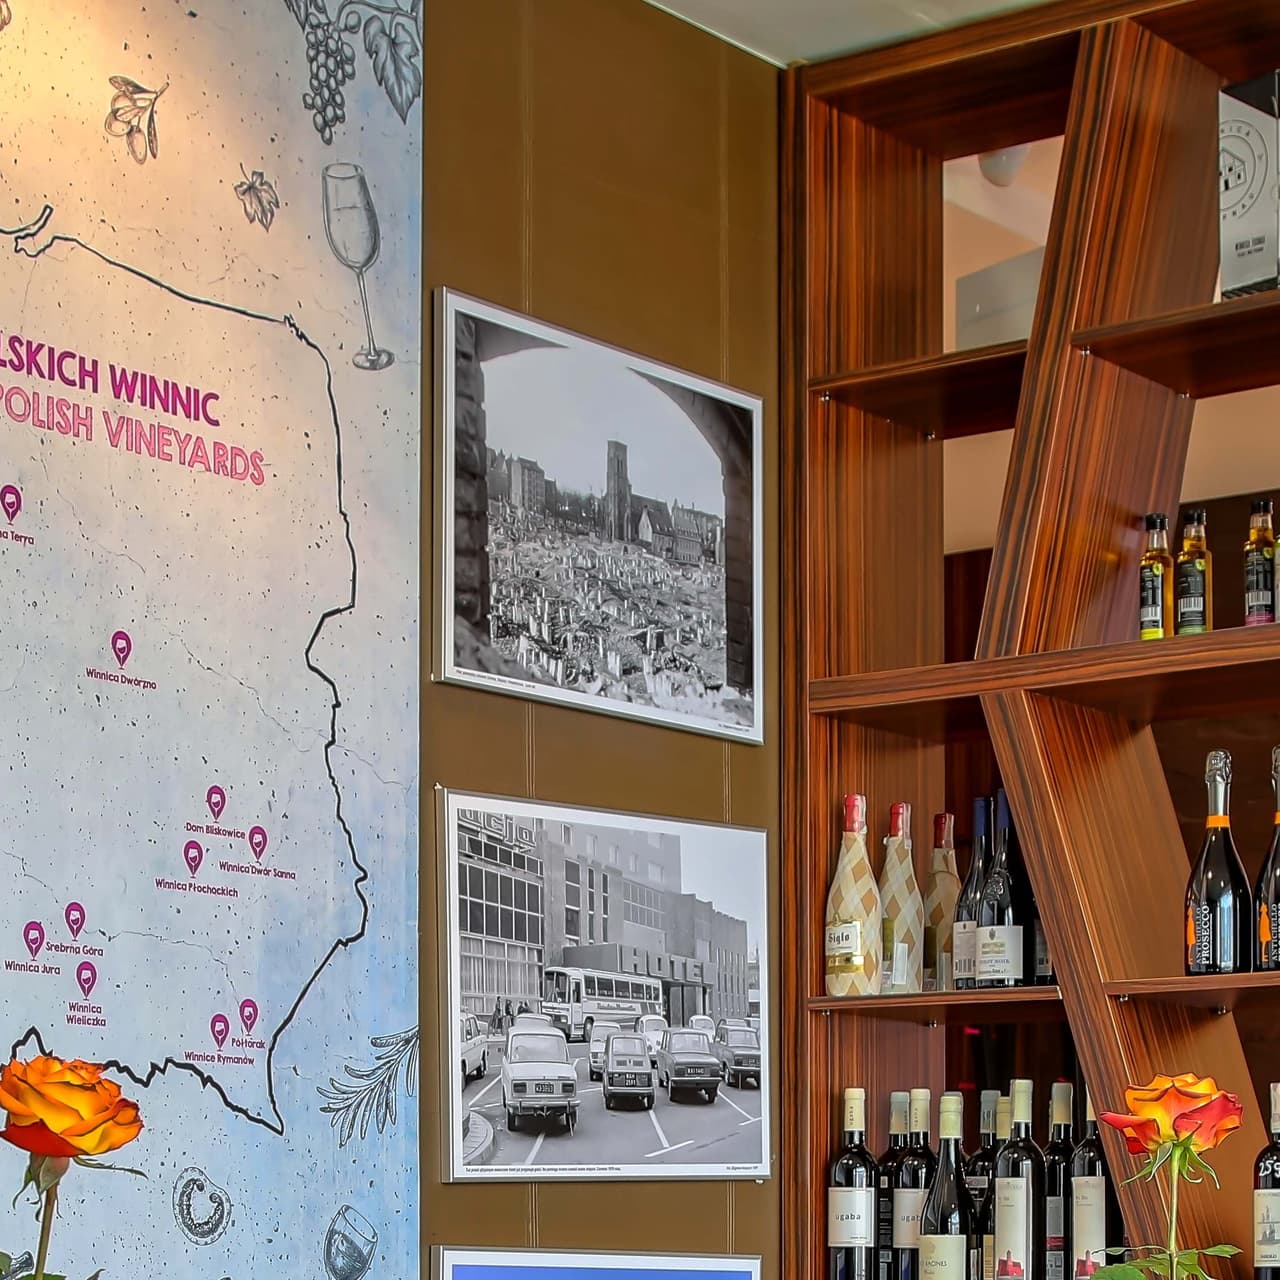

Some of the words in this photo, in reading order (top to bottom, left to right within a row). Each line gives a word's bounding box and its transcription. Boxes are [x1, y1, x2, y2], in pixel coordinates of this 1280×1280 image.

[108, 363, 220, 427] WINNIC
[102, 410, 265, 486] VINEYARDS
[10, 530, 35, 546] Terra
[86, 667, 120, 683] Winnica
[120, 675, 157, 690] Dwórzno
[186, 822, 205, 833] Dom
[219, 861, 250, 874] Winnica
[273, 868, 296, 880] Sanna
[155, 878, 187, 892] Winnica
[188, 882, 239, 898] Płochockich
[828, 931, 850, 945] Siglo
[1202, 905, 1210, 965] PROSECCO
[46, 942, 81, 955] Srebrna
[82, 944, 104, 957] Góra
[4, 960, 40, 973] Winnica
[41, 963, 61, 975] Jura
[68, 1002, 102, 1014] Winnica
[66, 1014, 106, 1026] Wieliczka
[184, 1050, 216, 1063] Winnice
[835, 1213, 862, 1222] ugaba
[901, 1214, 921, 1223] ugab
